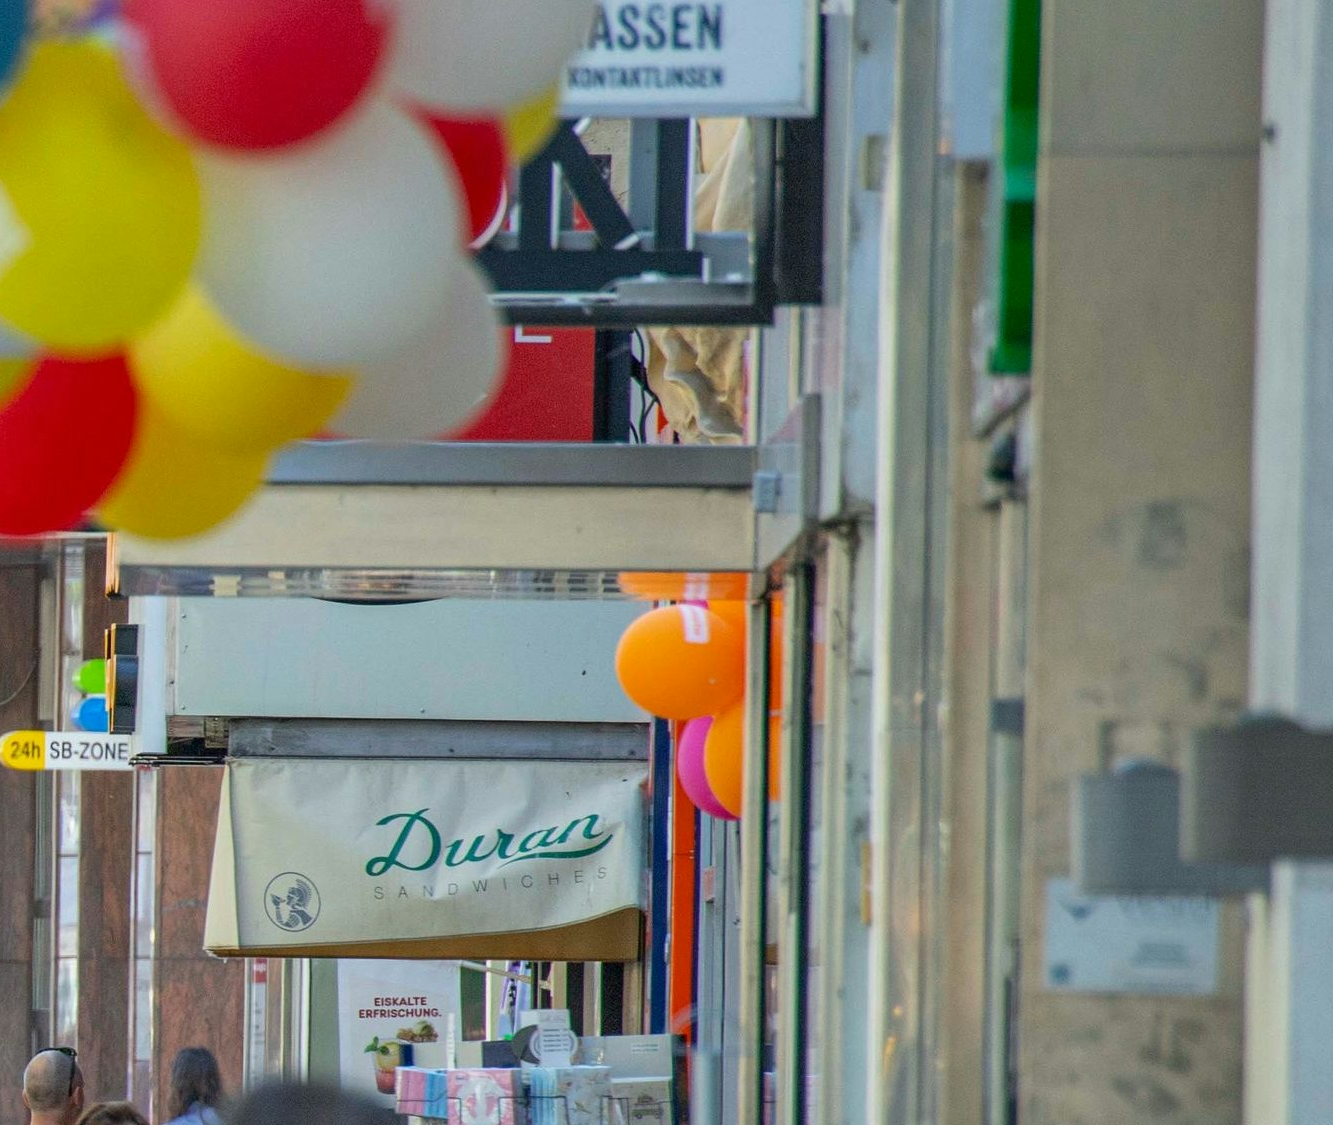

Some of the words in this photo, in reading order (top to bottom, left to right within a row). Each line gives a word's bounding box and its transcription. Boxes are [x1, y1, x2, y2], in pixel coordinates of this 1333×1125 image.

[589, 3, 724, 50] ASSEN
[566, 66, 724, 88] KONTAKTLINSEN
[11, 741, 41, 759] 24h
[49, 741, 130, 761] SB-ZONE
[366, 808, 613, 877] Duran
[374, 866, 609, 900] SANDWICHES
[374, 997, 427, 1007] EISKALTE
[359, 1008, 442, 1019] ERFRISCHUNG.
